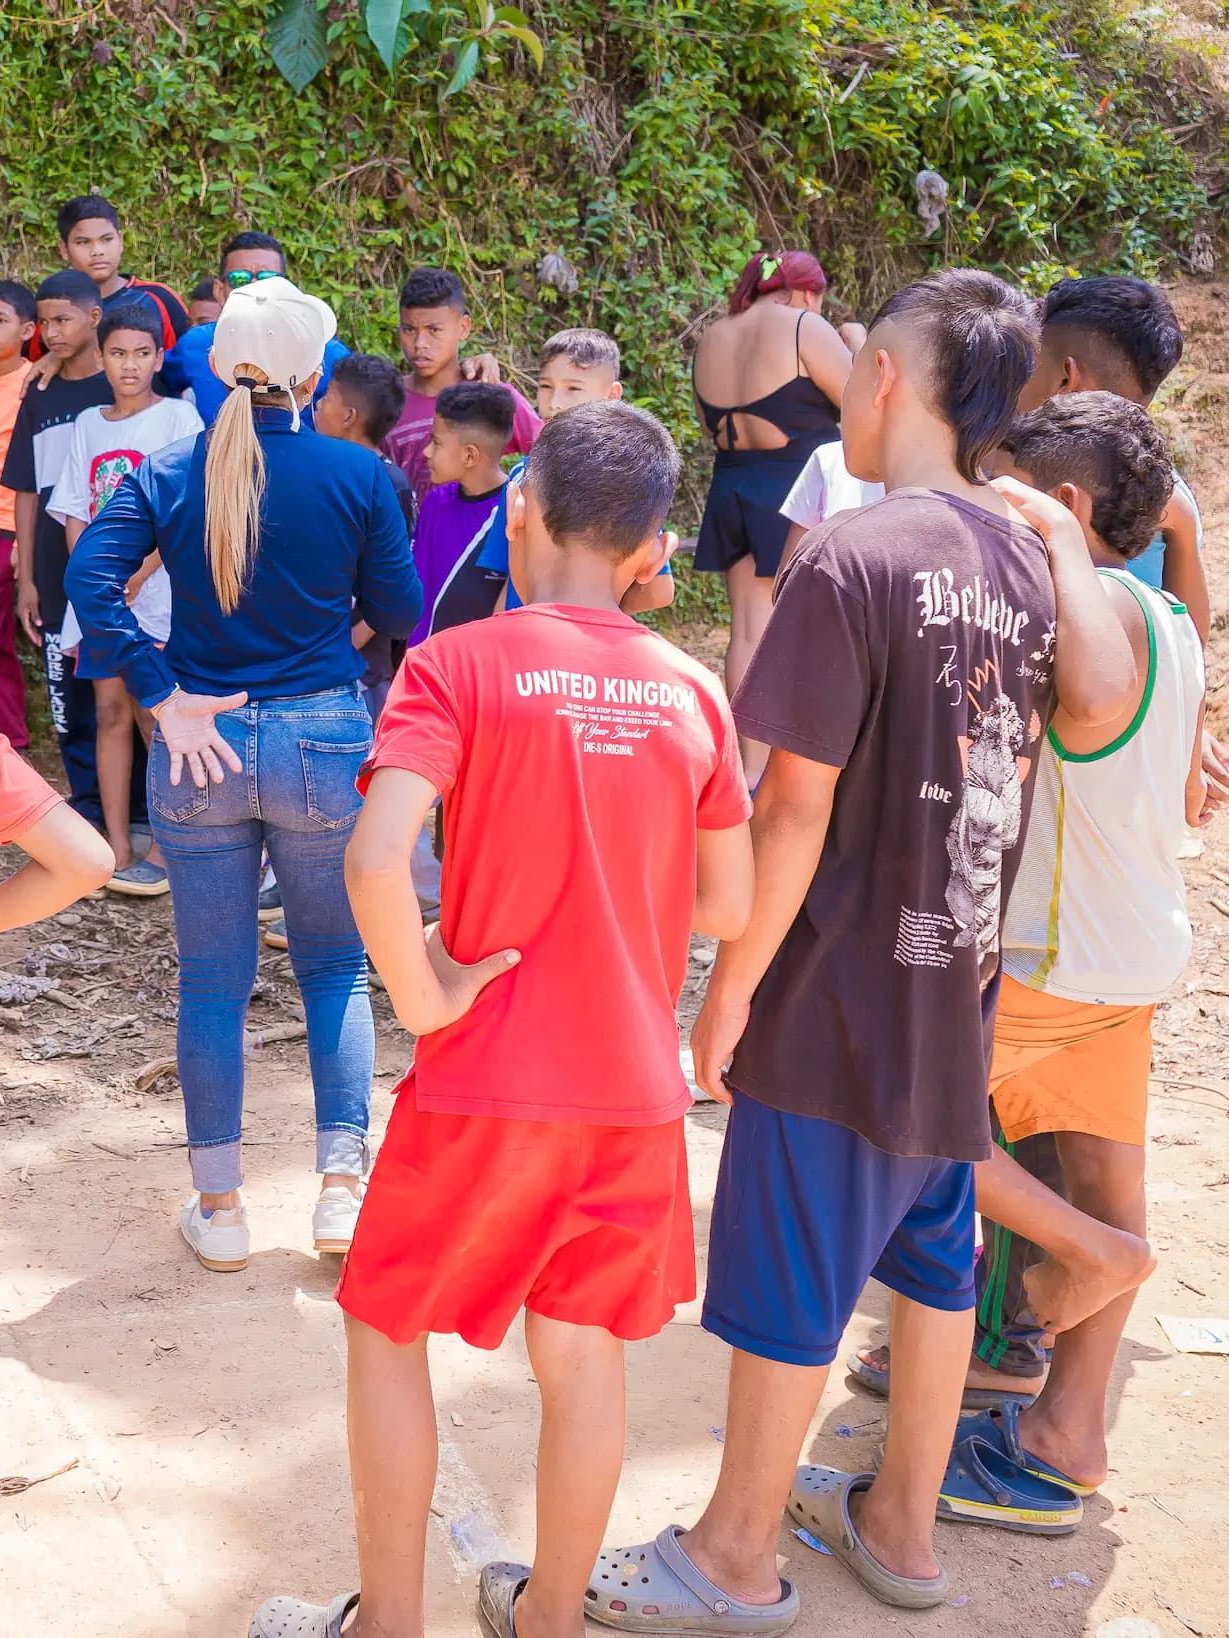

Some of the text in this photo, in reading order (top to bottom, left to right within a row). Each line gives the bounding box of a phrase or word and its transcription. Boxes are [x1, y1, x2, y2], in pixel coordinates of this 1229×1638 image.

[44, 632, 65, 682] MADRE
[515, 670, 696, 714] UNITED KINGDOM
[584, 705, 596, 713] CAN
[584, 722, 610, 740] Your
[643, 718, 659, 726] YOUR
[602, 743, 635, 757] ORIGINAL
[919, 780, 953, 804] love
